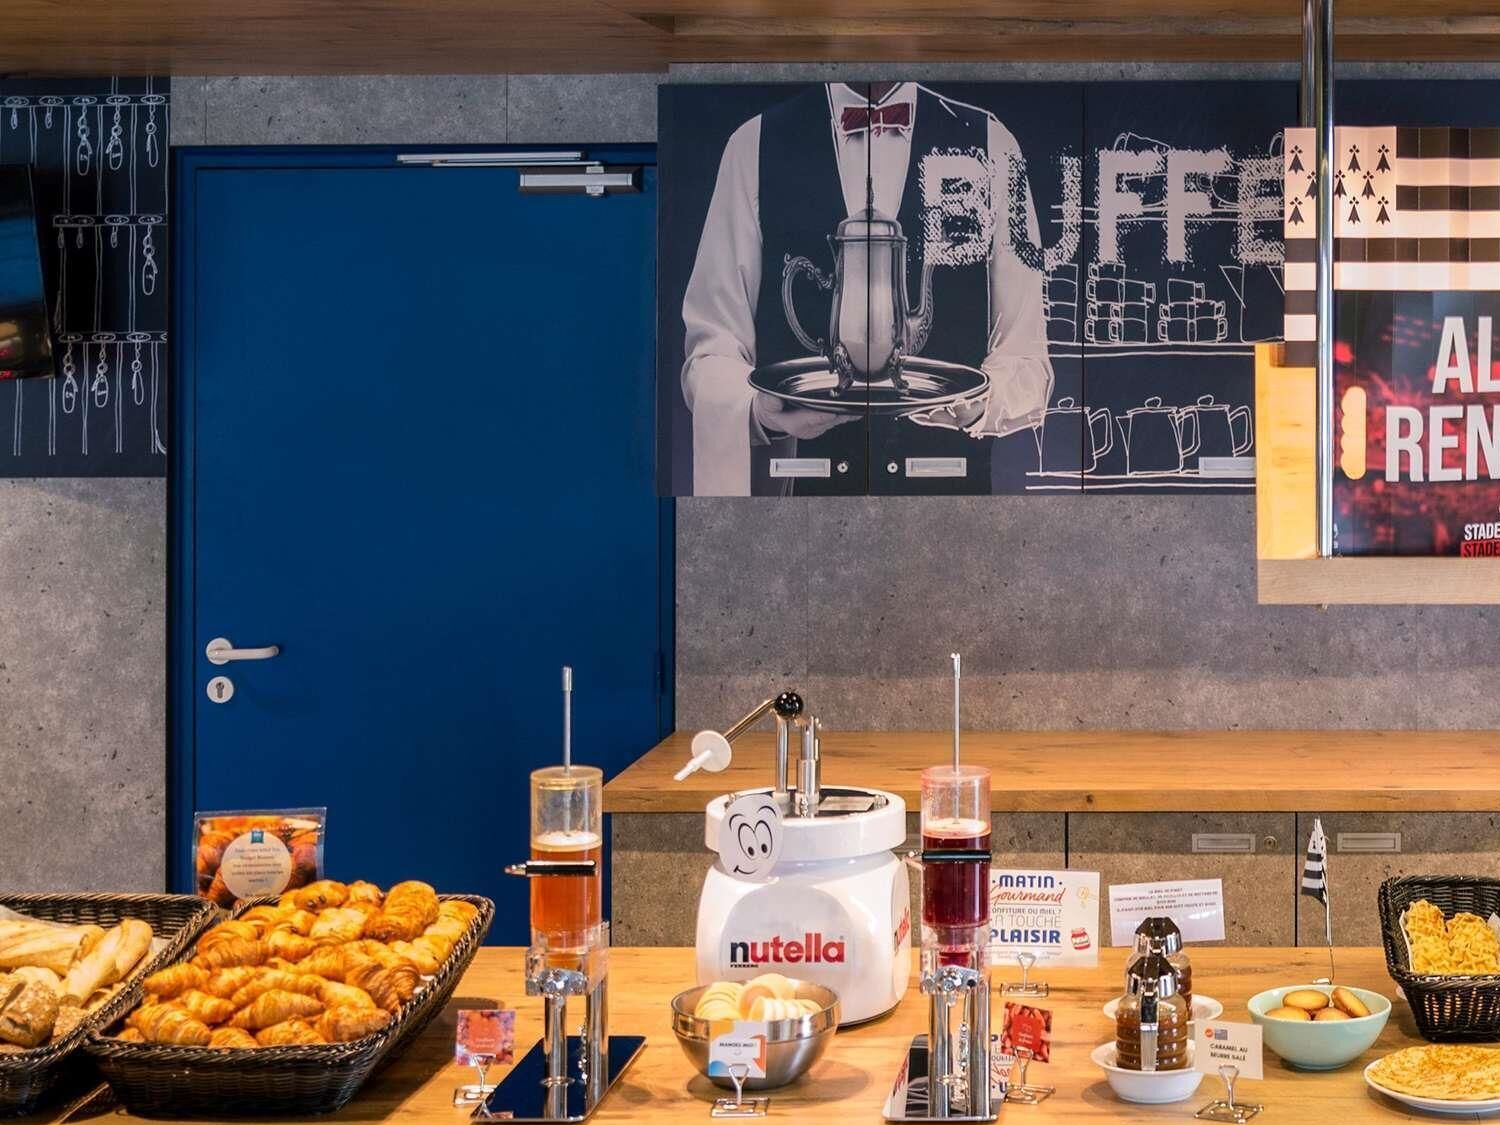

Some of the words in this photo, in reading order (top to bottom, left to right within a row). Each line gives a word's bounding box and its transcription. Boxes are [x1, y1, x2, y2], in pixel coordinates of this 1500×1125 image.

[1463, 541, 1500, 557] STADE
[999, 875, 1054, 888] MATIN
[990, 884, 1067, 906] Gourmand
[989, 929, 1061, 943] PLAISIR
[730, 933, 845, 963] nutella
[1210, 1043, 1237, 1052] CARAMEL
